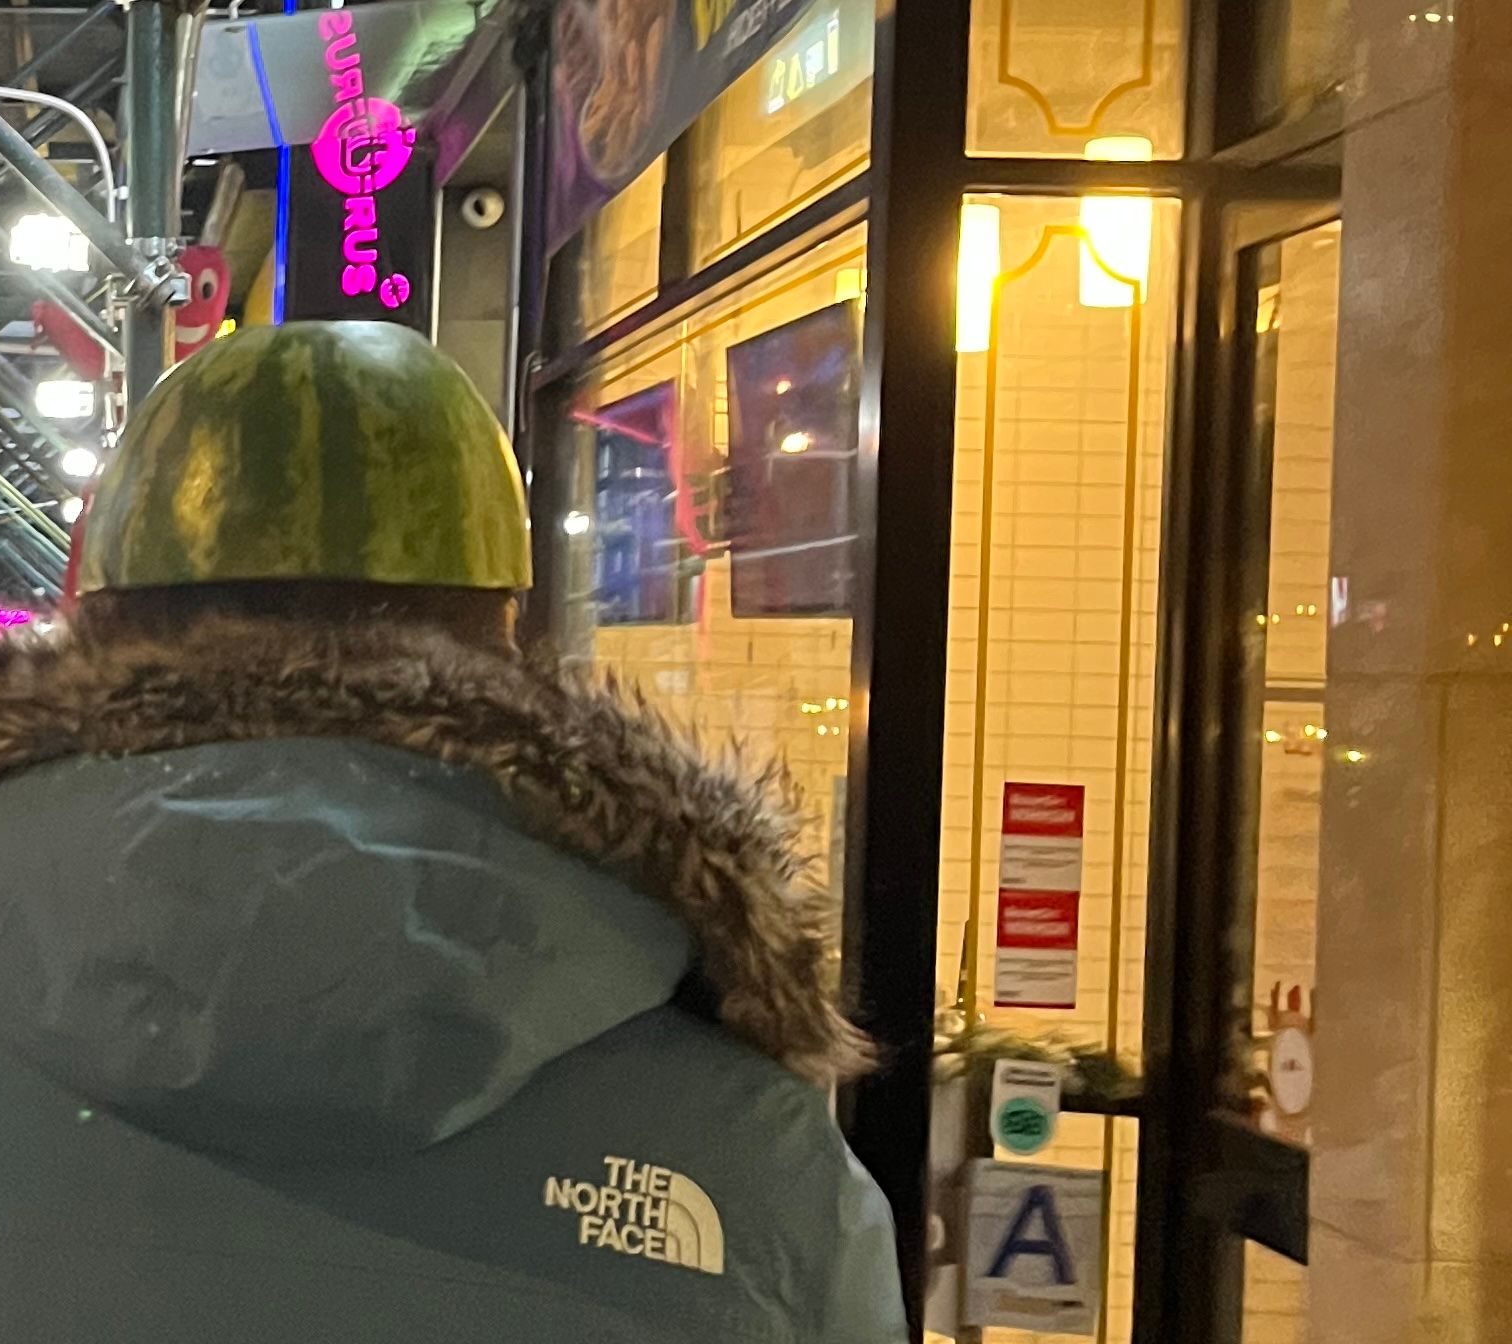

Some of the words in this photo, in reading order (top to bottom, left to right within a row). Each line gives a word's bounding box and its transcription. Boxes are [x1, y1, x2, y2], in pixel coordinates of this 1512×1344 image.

[544, 1176, 667, 1229] NORTH
[603, 1156, 672, 1199] THE
[579, 1214, 667, 1261] FACE
[984, 1184, 1078, 1285] A
